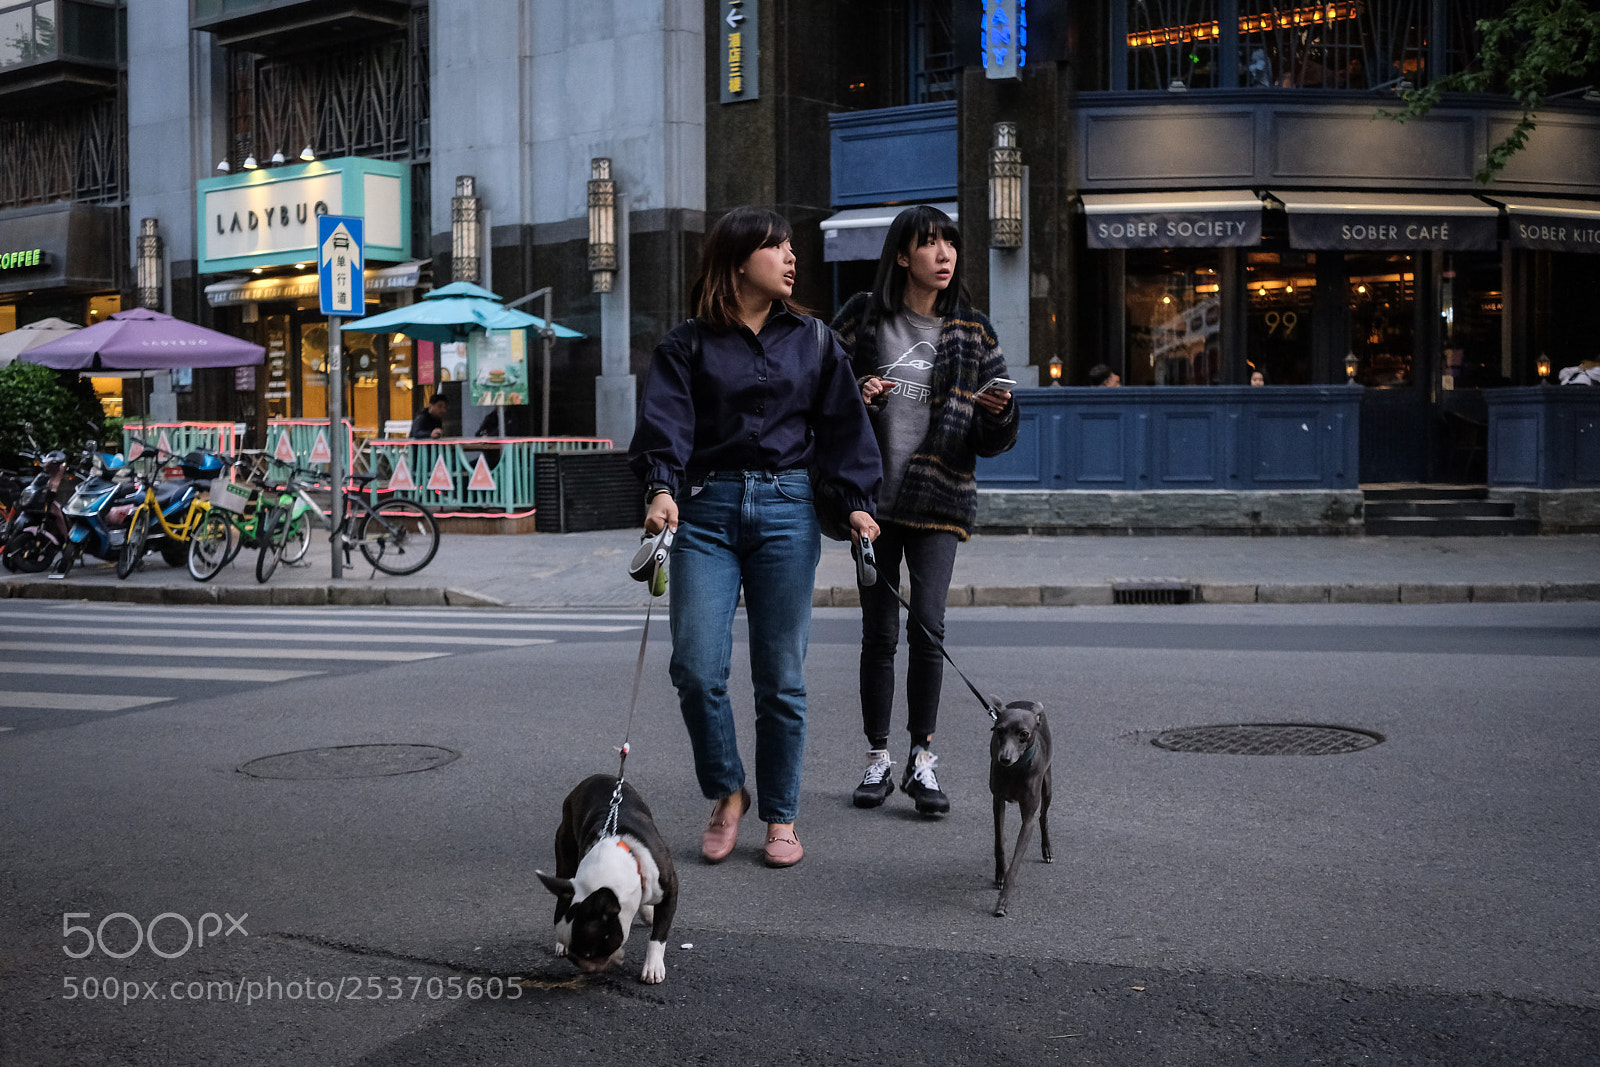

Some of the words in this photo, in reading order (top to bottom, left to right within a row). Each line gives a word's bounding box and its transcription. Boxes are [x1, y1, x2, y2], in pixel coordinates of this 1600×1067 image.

[991, 0, 1010, 66] ANY
[216, 201, 328, 234] LADYBUG
[1099, 223, 1158, 238] SOBER
[1167, 221, 1246, 237] SOCIETY
[1342, 225, 1398, 240] SOBER
[1406, 223, 1449, 240] CAFÉ
[1519, 224, 1567, 240] SOBER
[336, 256, 346, 304] 单行道
[1265, 311, 1297, 334] 99
